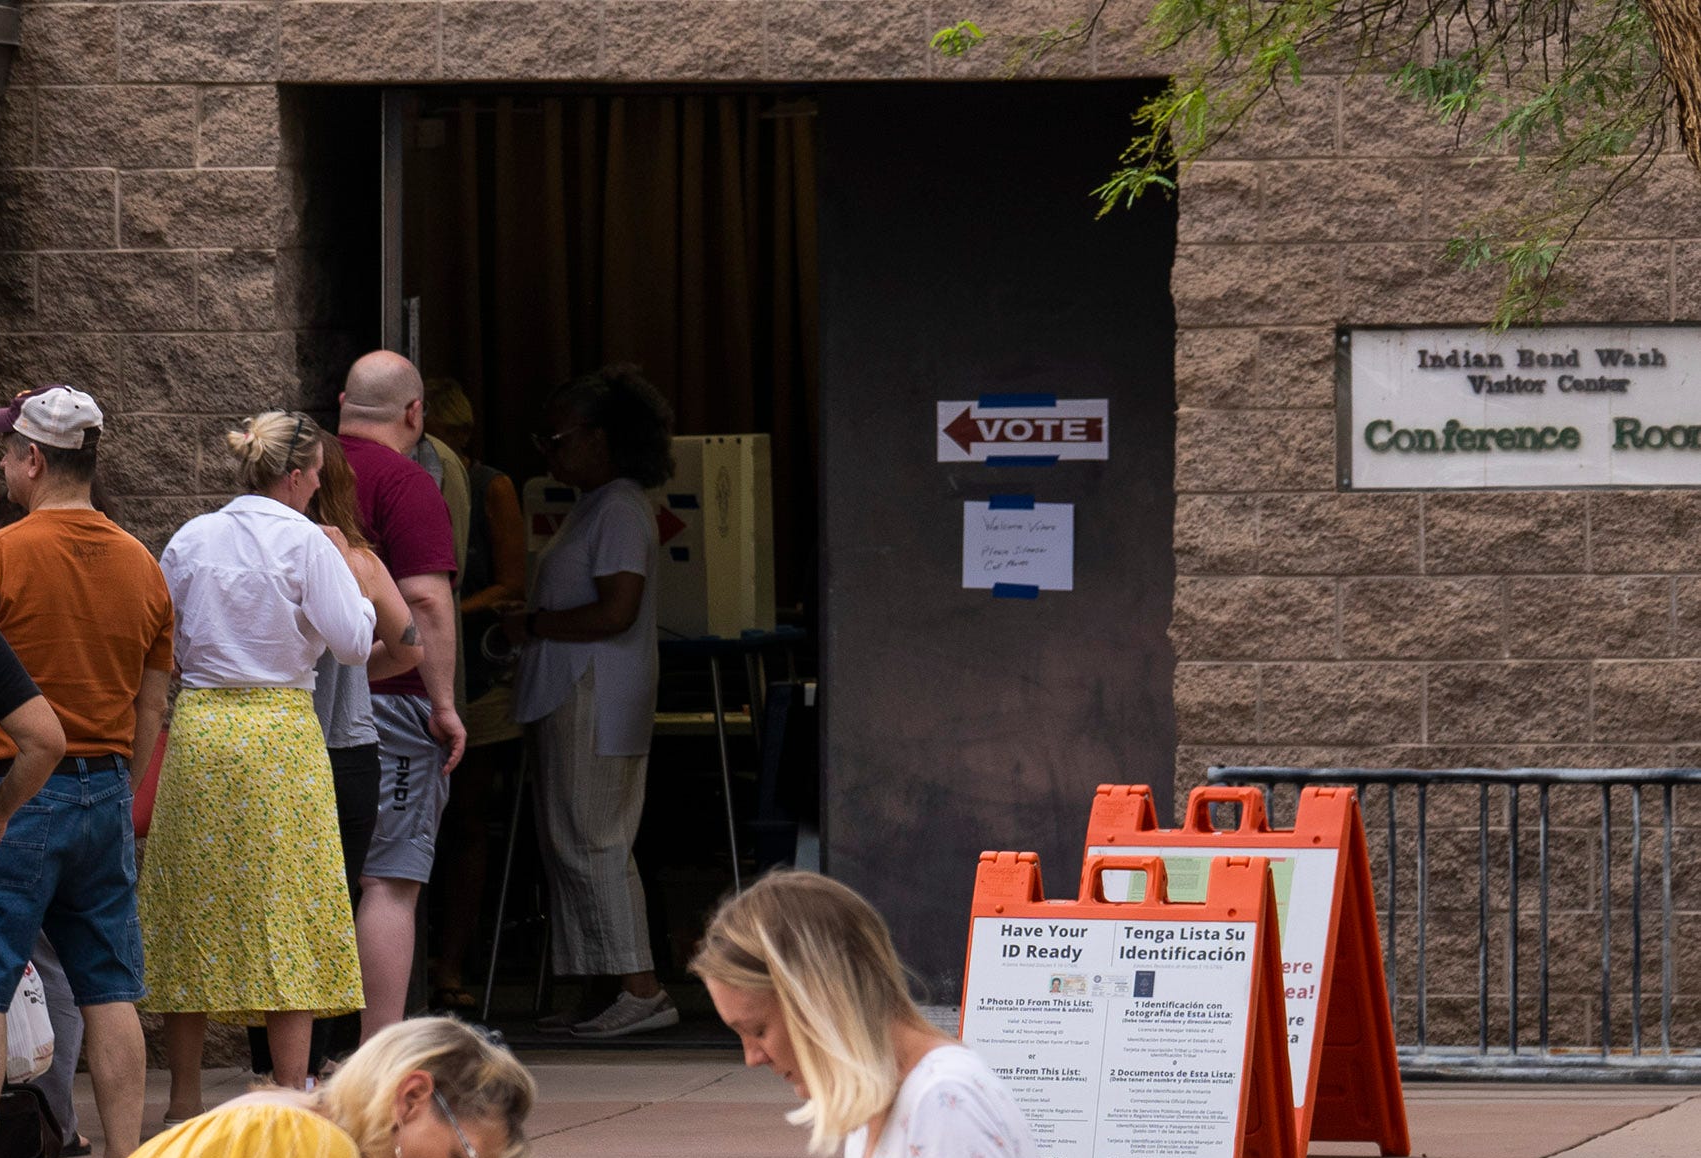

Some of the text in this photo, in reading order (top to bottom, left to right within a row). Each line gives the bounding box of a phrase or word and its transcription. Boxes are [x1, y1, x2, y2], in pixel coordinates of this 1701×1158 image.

[1418, 348, 1666, 368] Indian Bend Wash
[1467, 375, 1630, 394] Visitor Center
[976, 419, 1088, 441] VOTE
[1364, 419, 1581, 453] Conference
[1001, 924, 1088, 938] Have Your
[1124, 927, 1245, 943] Tenga Lista Su
[1002, 945, 1083, 963] ID Ready
[1120, 946, 1246, 961] Identificación
[987, 998, 1013, 1006] Photo
[1053, 999, 1071, 1007] This
[1074, 999, 1093, 1007] List:
[1142, 1001, 1204, 1009] Identificación
[1125, 1010, 1171, 1019] Fotografía
[1187, 1010, 1205, 1018] Esta
[1208, 1011, 1233, 1019] Lista:
[1062, 1068, 1081, 1076] List:
[1118, 1069, 1174, 1077] Documentos
[1190, 1070, 1208, 1078] Esta
[1211, 1070, 1236, 1079] Lista:
